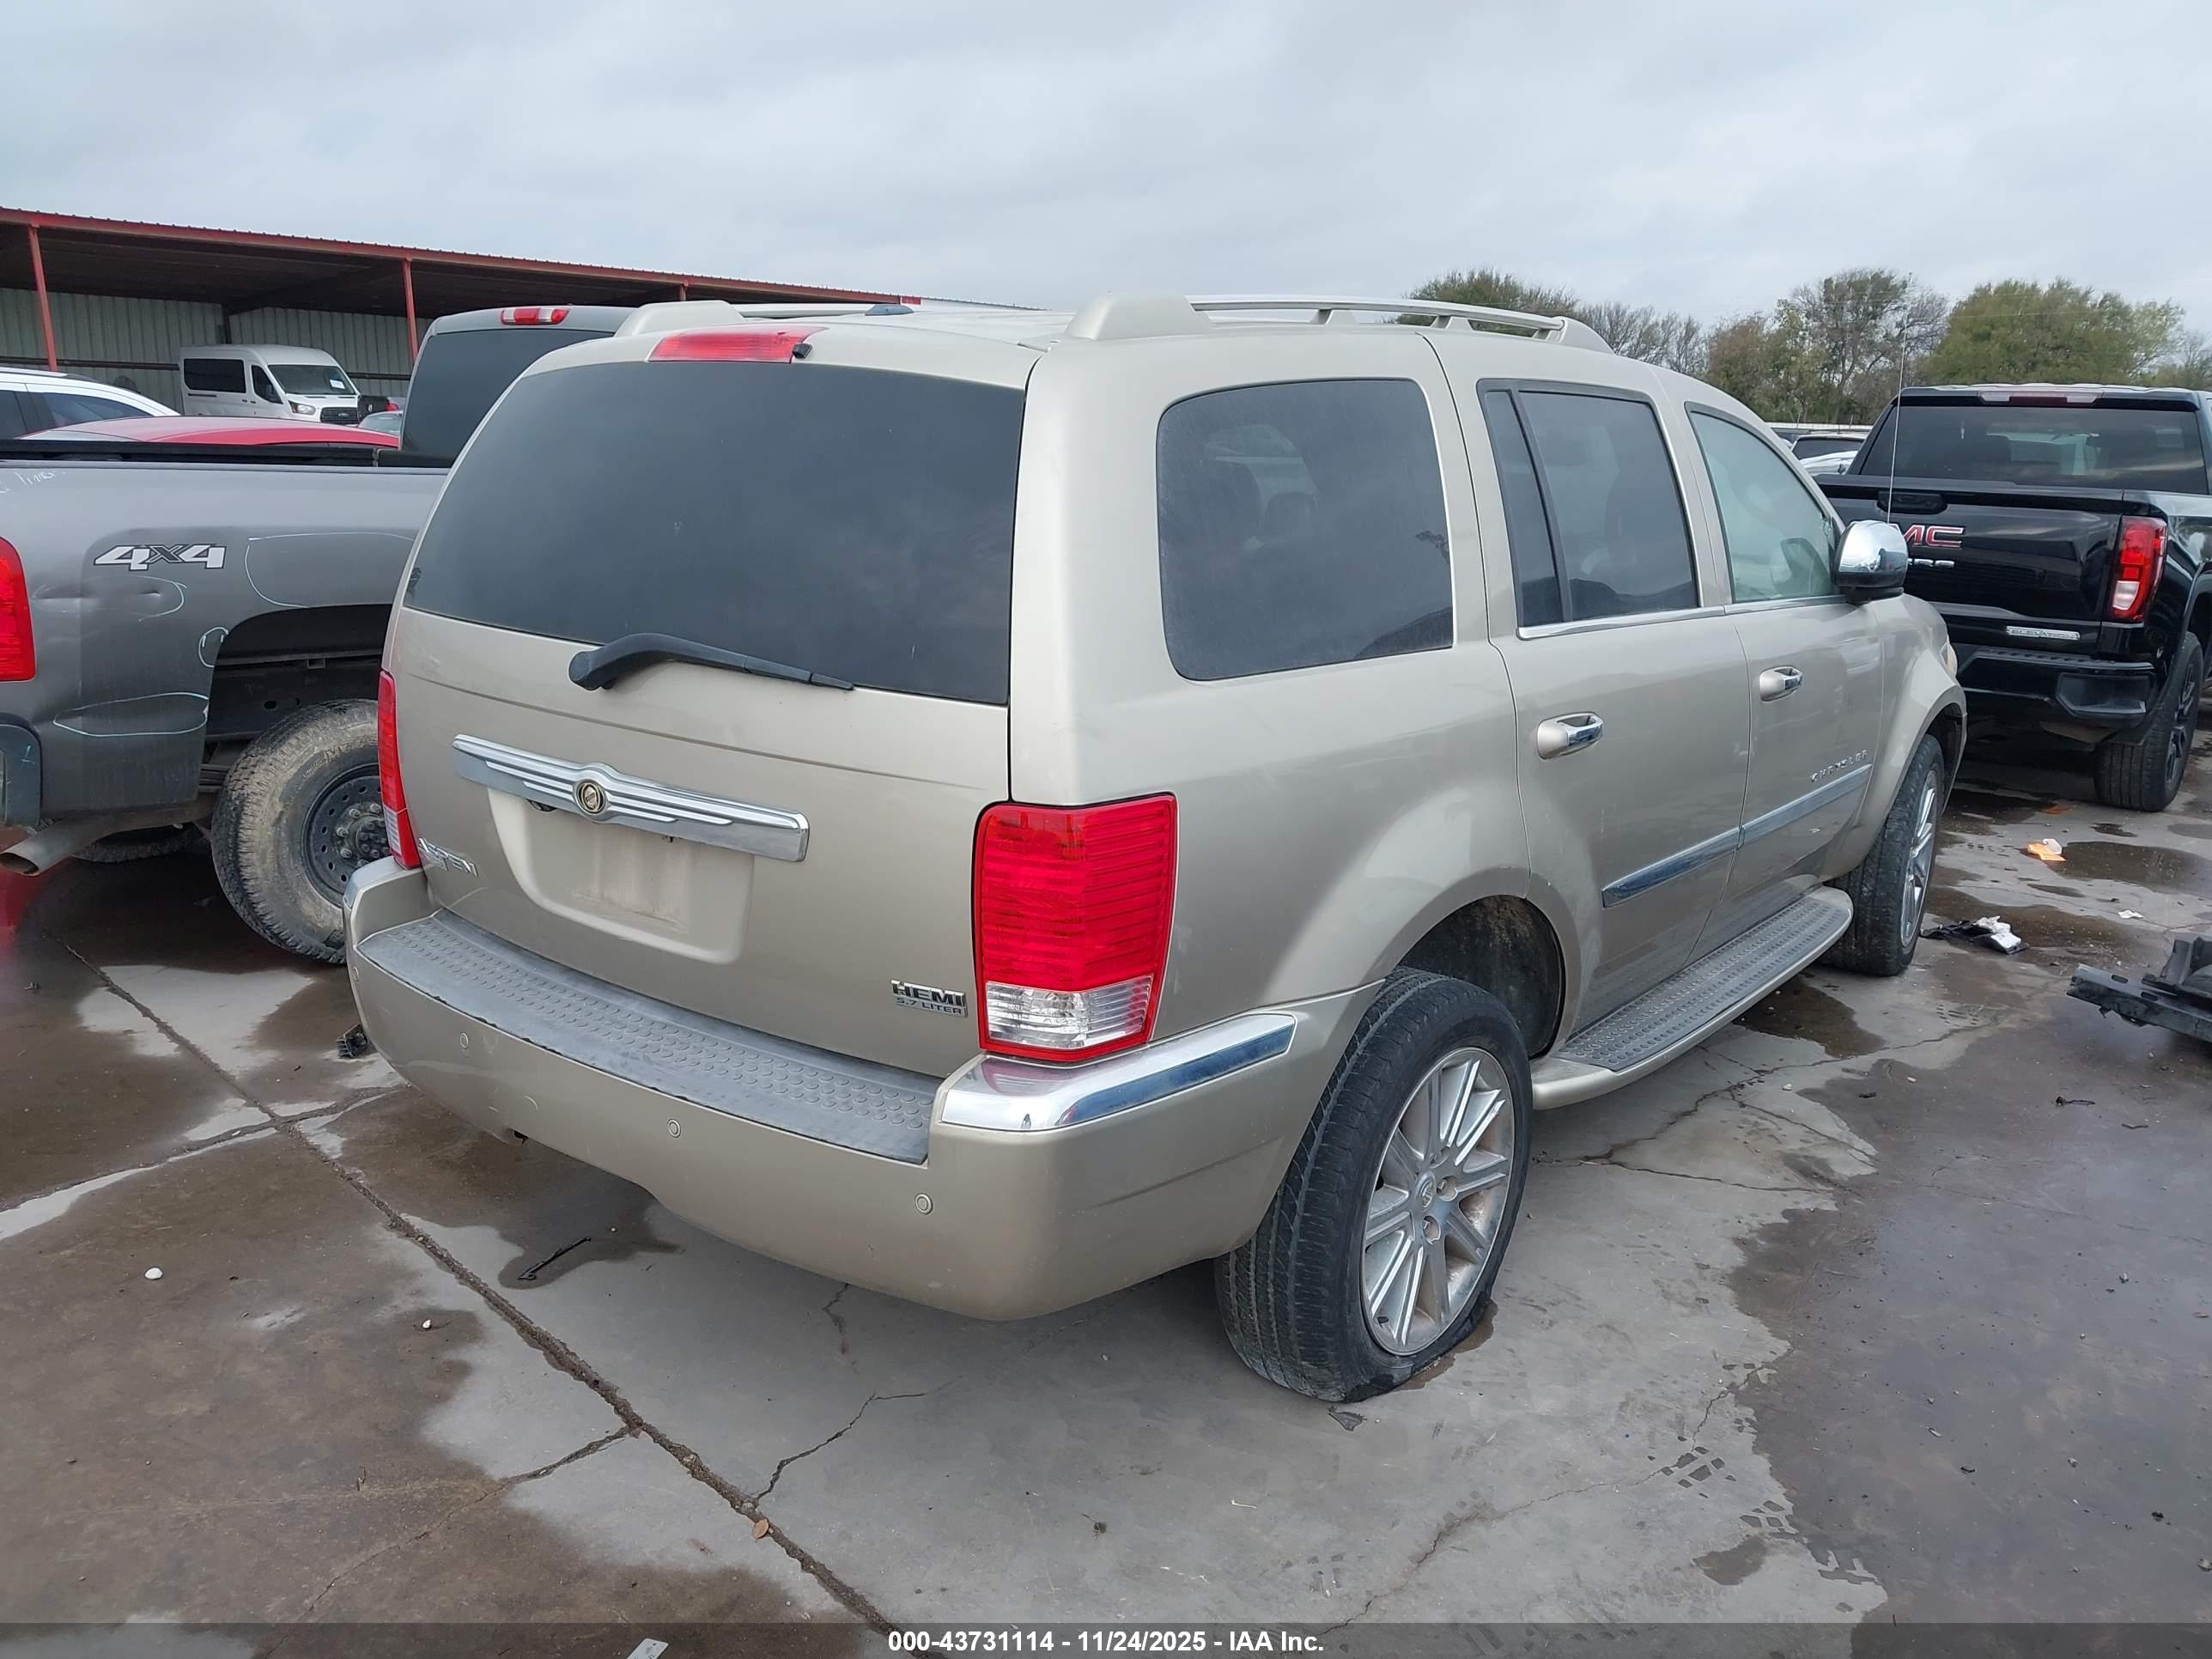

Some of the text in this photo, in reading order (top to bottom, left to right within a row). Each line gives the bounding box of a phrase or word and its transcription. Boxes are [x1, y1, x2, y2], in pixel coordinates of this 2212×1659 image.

[1888, 524, 1965, 548] MC
[1811, 750, 1868, 782] CHRYSLER
[891, 980, 966, 1007] HEMI
[896, 996, 963, 1015] 5.7 LITER
